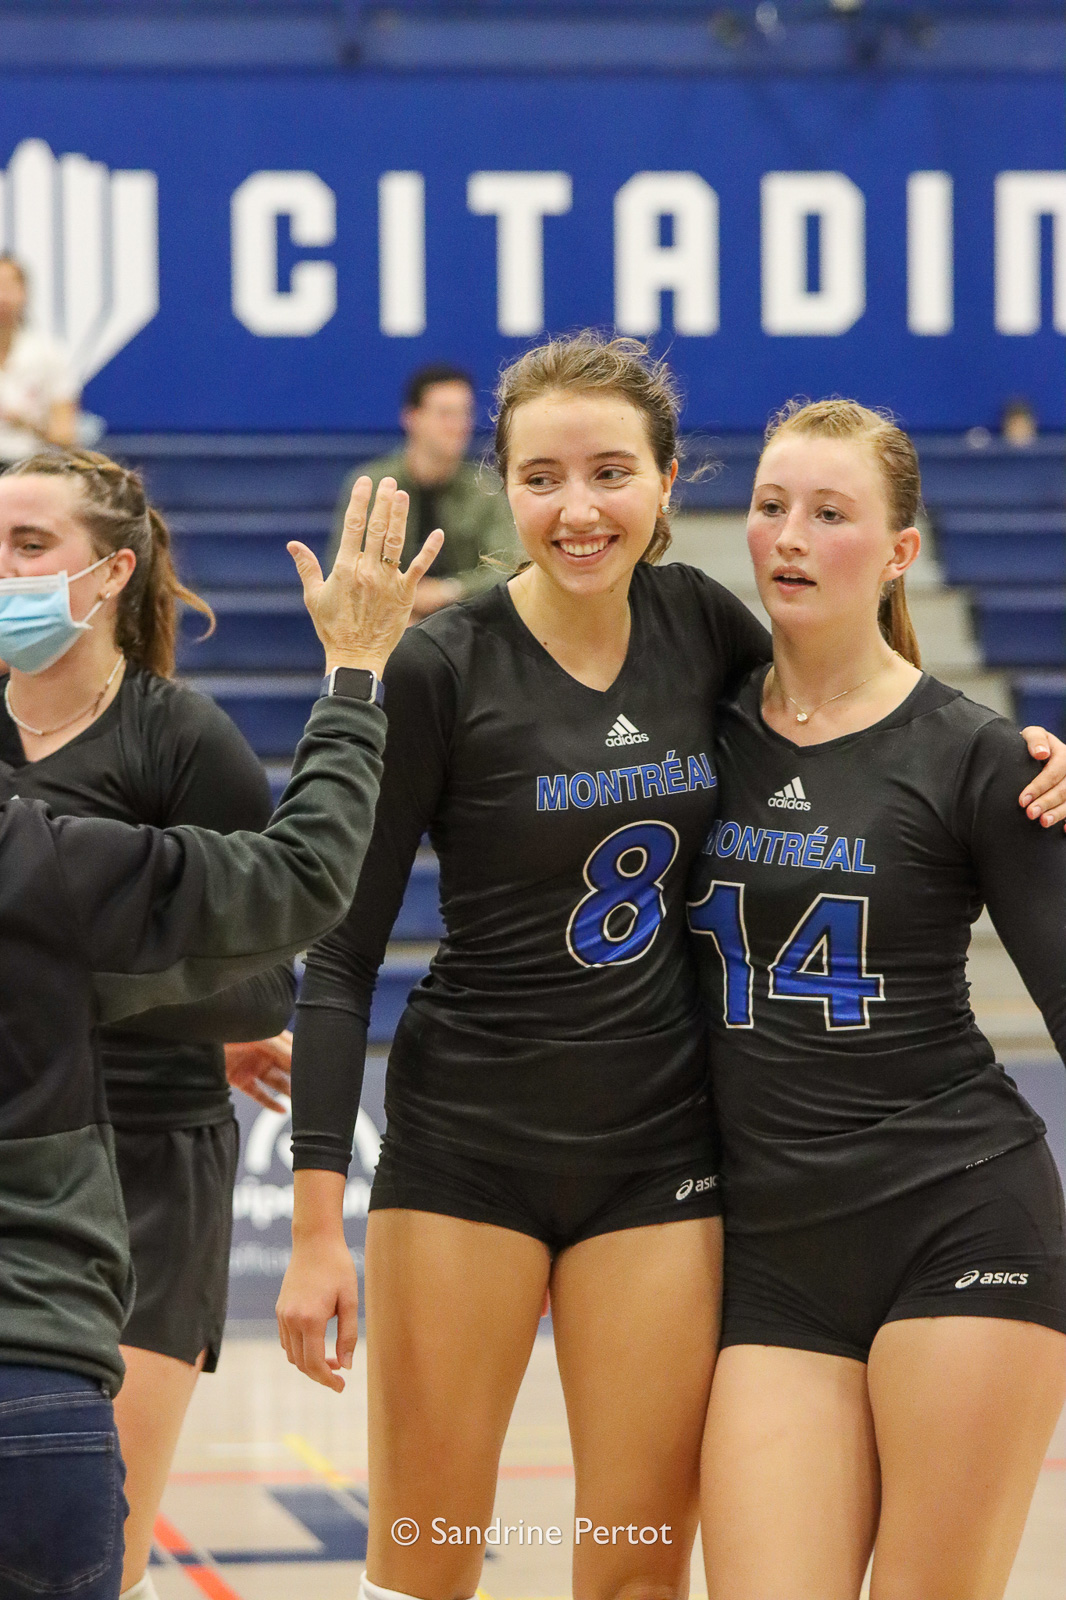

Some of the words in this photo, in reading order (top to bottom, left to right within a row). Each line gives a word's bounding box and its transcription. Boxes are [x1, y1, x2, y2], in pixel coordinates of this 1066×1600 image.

[605, 733, 650, 747] adidas
[536, 749, 718, 811] MONTRÉAL
[767, 797, 812, 811] adidas
[566, 820, 680, 968] 8
[686, 880, 886, 1031] 14
[980, 1272, 1029, 1285] asics
